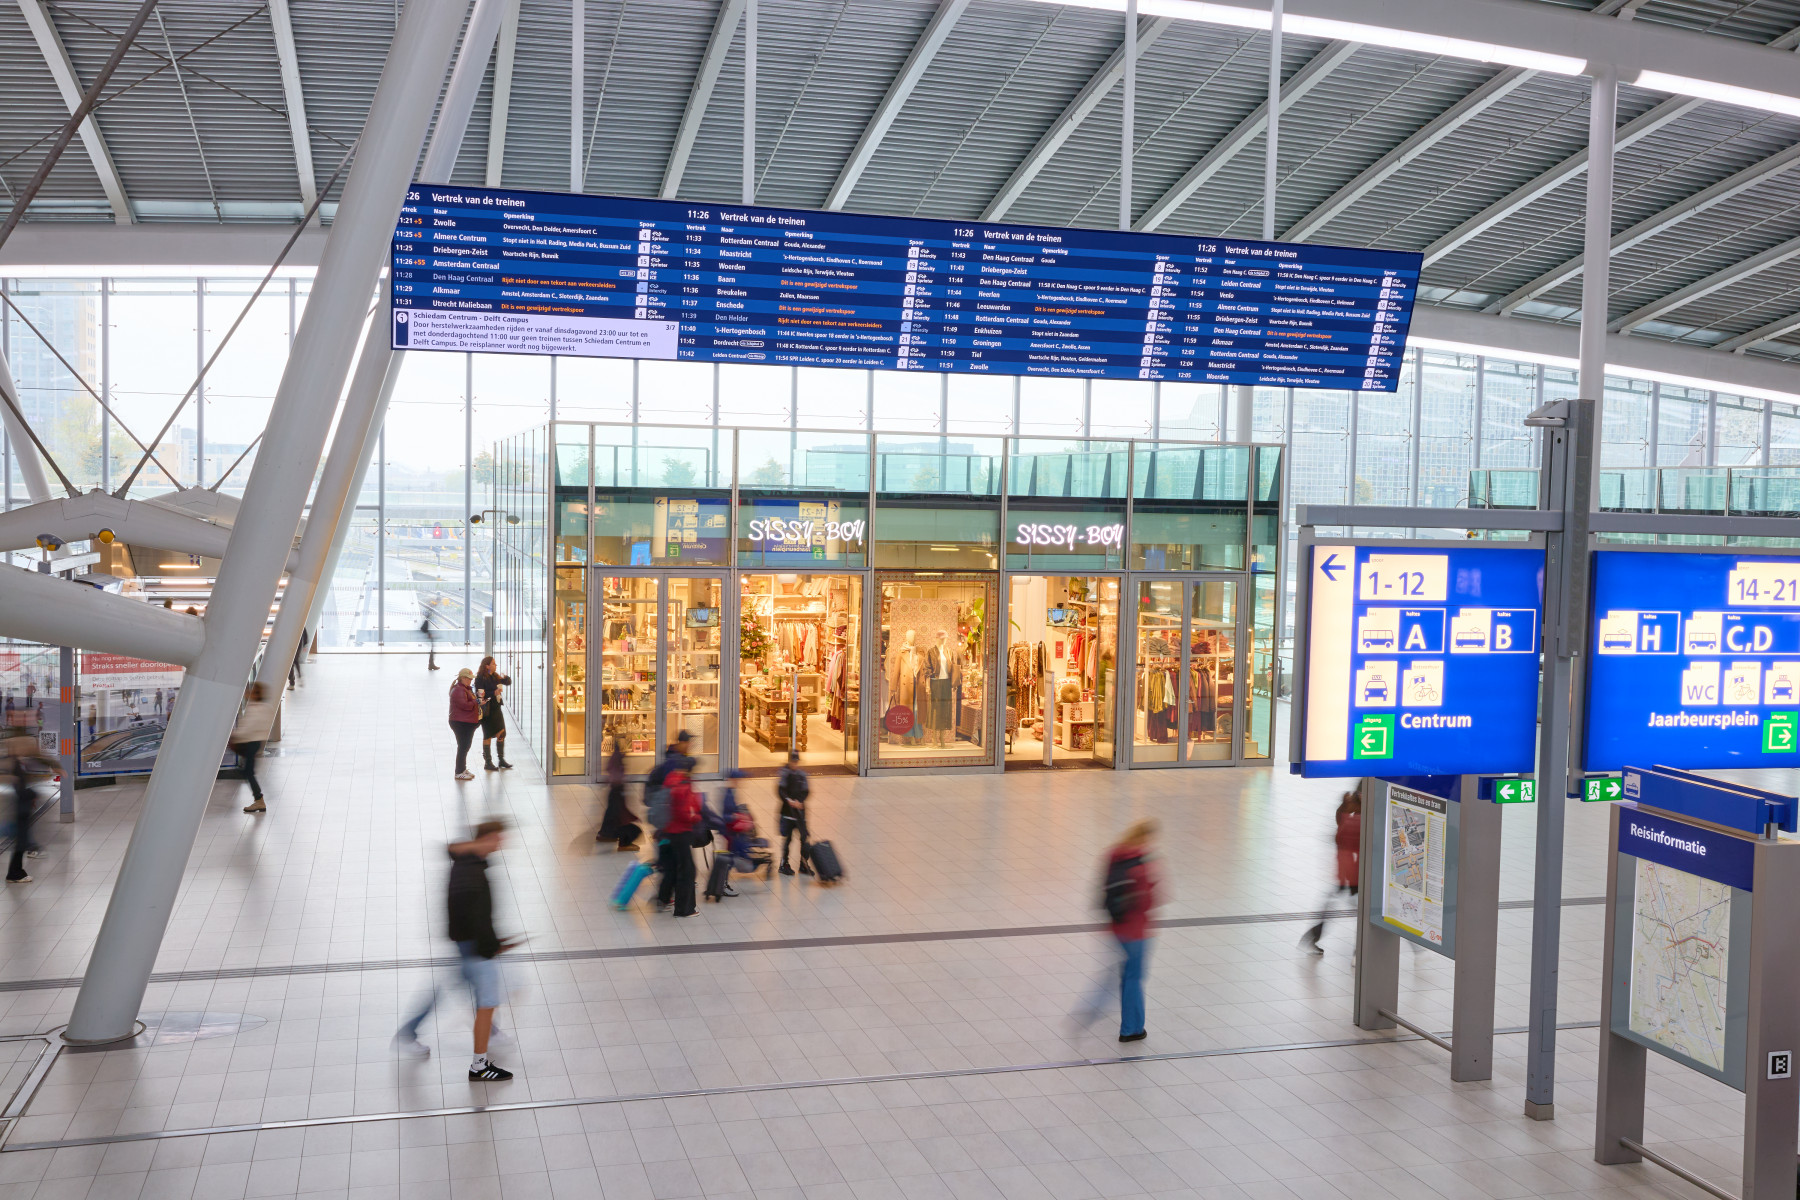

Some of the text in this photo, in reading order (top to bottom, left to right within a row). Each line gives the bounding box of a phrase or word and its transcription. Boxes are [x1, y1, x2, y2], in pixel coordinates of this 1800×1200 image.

[407, 192, 420, 200] :26
[432, 193, 525, 207] Vertrek van de treinen
[688, 210, 709, 219] 11:26
[720, 212, 748, 222] Vertrek
[767, 215, 776, 224] de
[779, 217, 805, 225] treinen
[954, 229, 974, 237] 11:26
[984, 231, 1009, 239] Vertrek
[1026, 233, 1034, 241] de
[721, 237, 752, 245] Rotterdam
[434, 246, 488, 256] Driebergen-Zeist
[720, 250, 752, 258] Maastricht
[1226, 246, 1249, 254] Vertrek
[433, 260, 470, 268] Amsterdam
[448, 275, 464, 283] Haag
[433, 287, 460, 295] Alkmaar
[716, 301, 744, 309] Enschede
[729, 314, 748, 322] Helder
[431, 322, 504, 331] herstelwerkzaamheden
[554, 327, 597, 336] dinsdagavond
[428, 331, 488, 340] donderdagochtend
[432, 340, 457, 349] Campus.
[472, 342, 504, 350] reisplanner
[542, 344, 576, 352] bijgewerkt.
[1405, 624, 1426, 649] A
[1496, 625, 1511, 649] B
[1642, 625, 1660, 650] H
[1727, 626, 1772, 652] C,D
[1687, 685, 1714, 700] WC
[1401, 713, 1471, 728] Centrum
[1648, 711, 1758, 729] Jaarbeursplein
[1631, 823, 1706, 855] Reisinformatie
